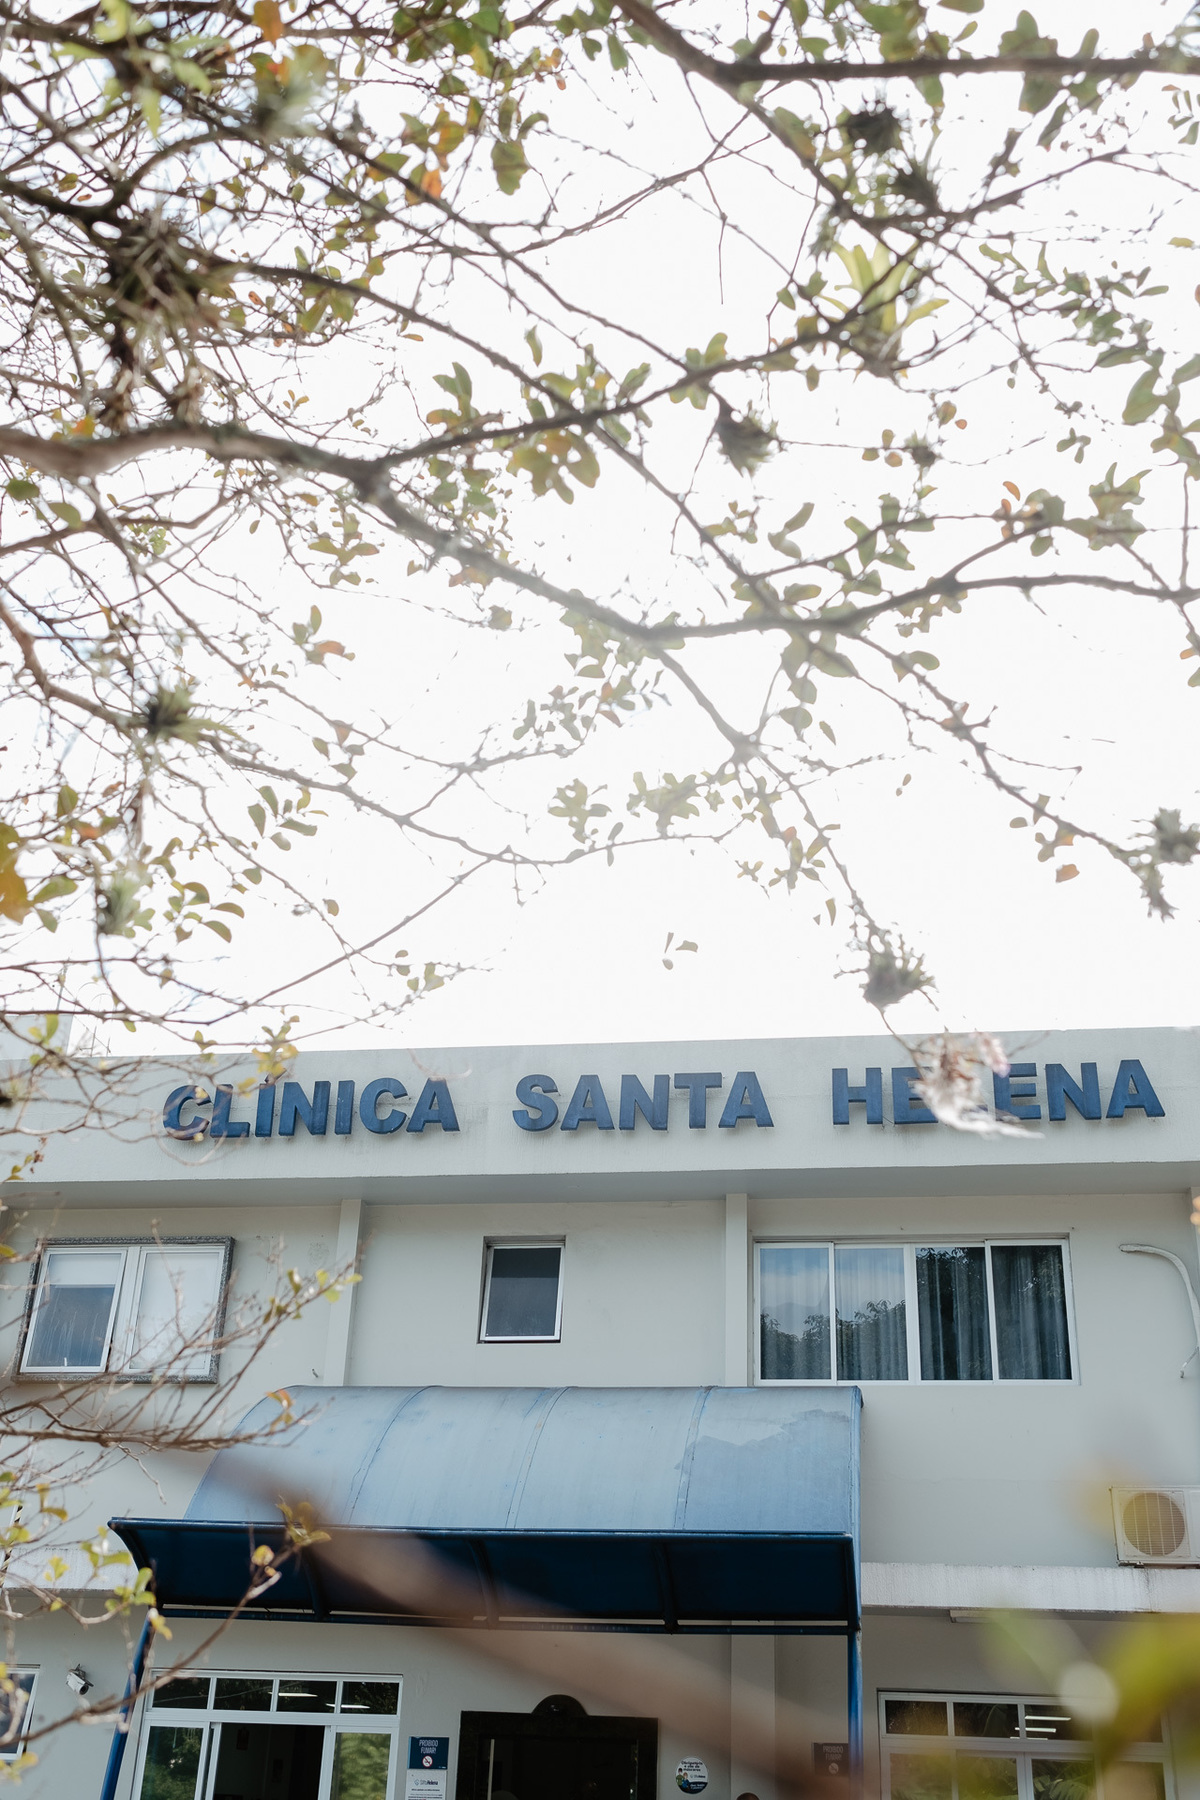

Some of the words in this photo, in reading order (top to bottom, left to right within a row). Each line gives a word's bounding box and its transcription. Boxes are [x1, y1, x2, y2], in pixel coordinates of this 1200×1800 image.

[162, 1069, 460, 1140] CLÍNICA
[512, 1071, 774, 1131] SANTA
[832, 1059, 1166, 1125] HEENA
